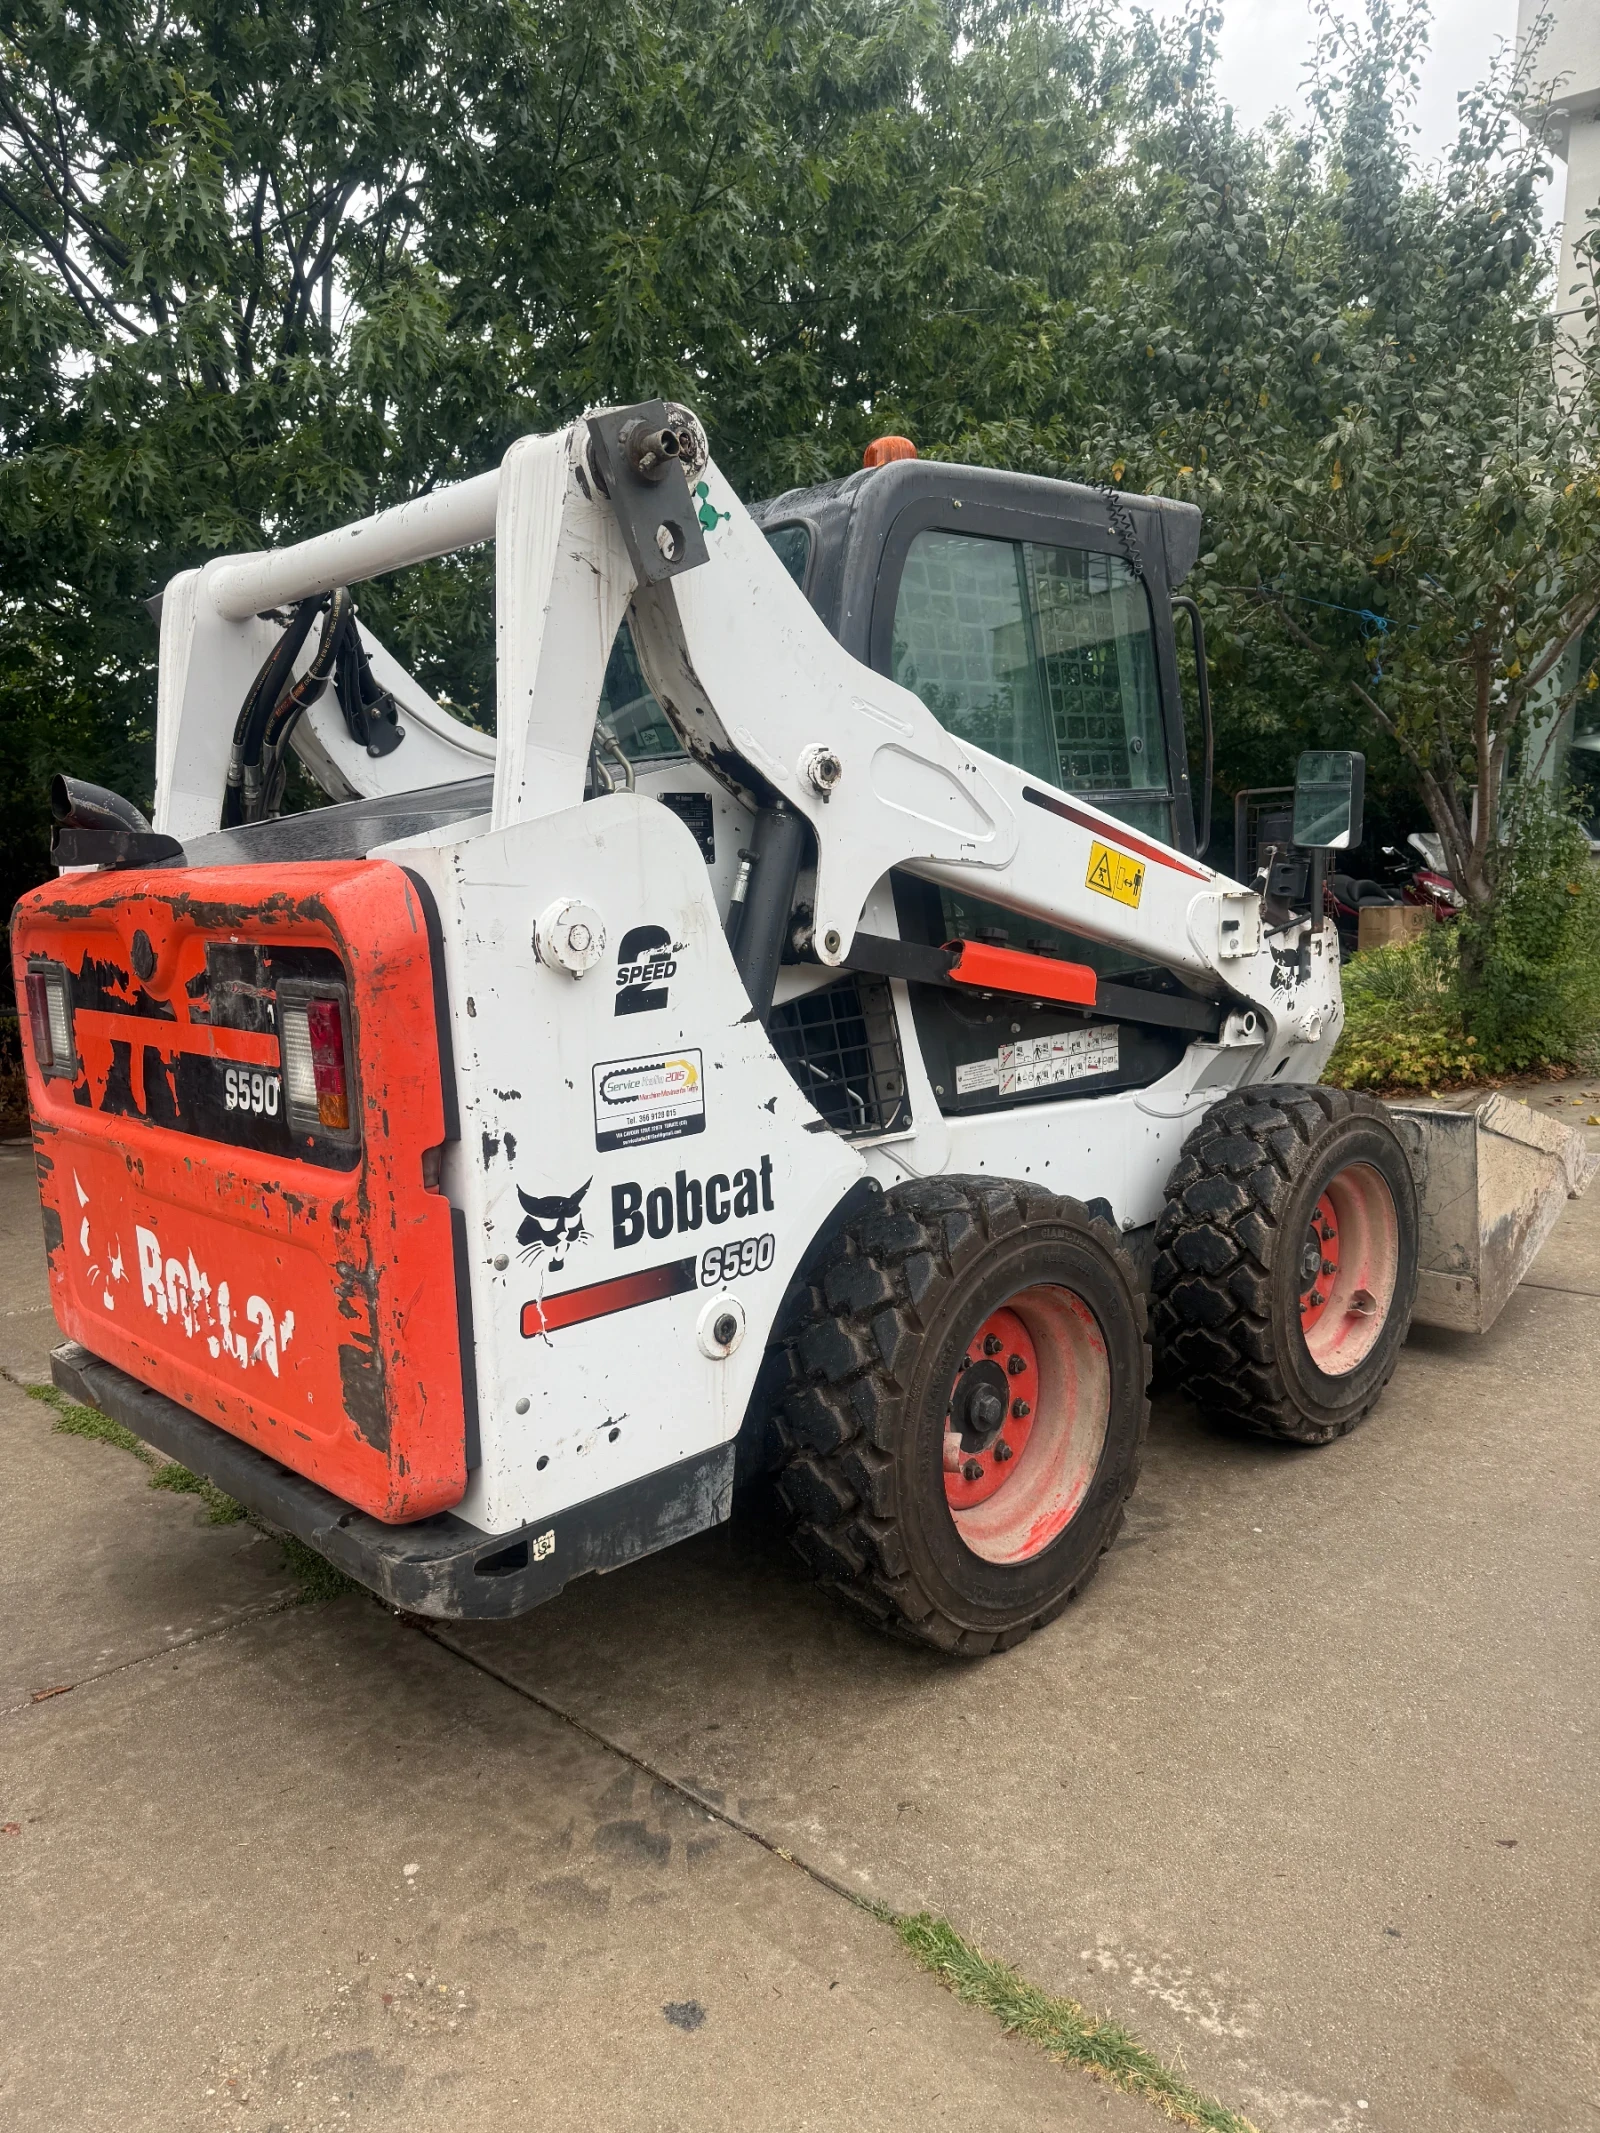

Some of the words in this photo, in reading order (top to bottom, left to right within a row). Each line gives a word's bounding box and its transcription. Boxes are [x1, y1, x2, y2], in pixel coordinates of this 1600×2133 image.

[616, 961, 677, 986] SPEED
[224, 1068, 280, 1117] S590
[607, 1080, 641, 1093] Service
[665, 1070, 685, 1083] 2015
[626, 1116, 638, 1125] Tel.
[611, 1153, 775, 1250] Bobcat
[701, 1233, 776, 1288] S590
